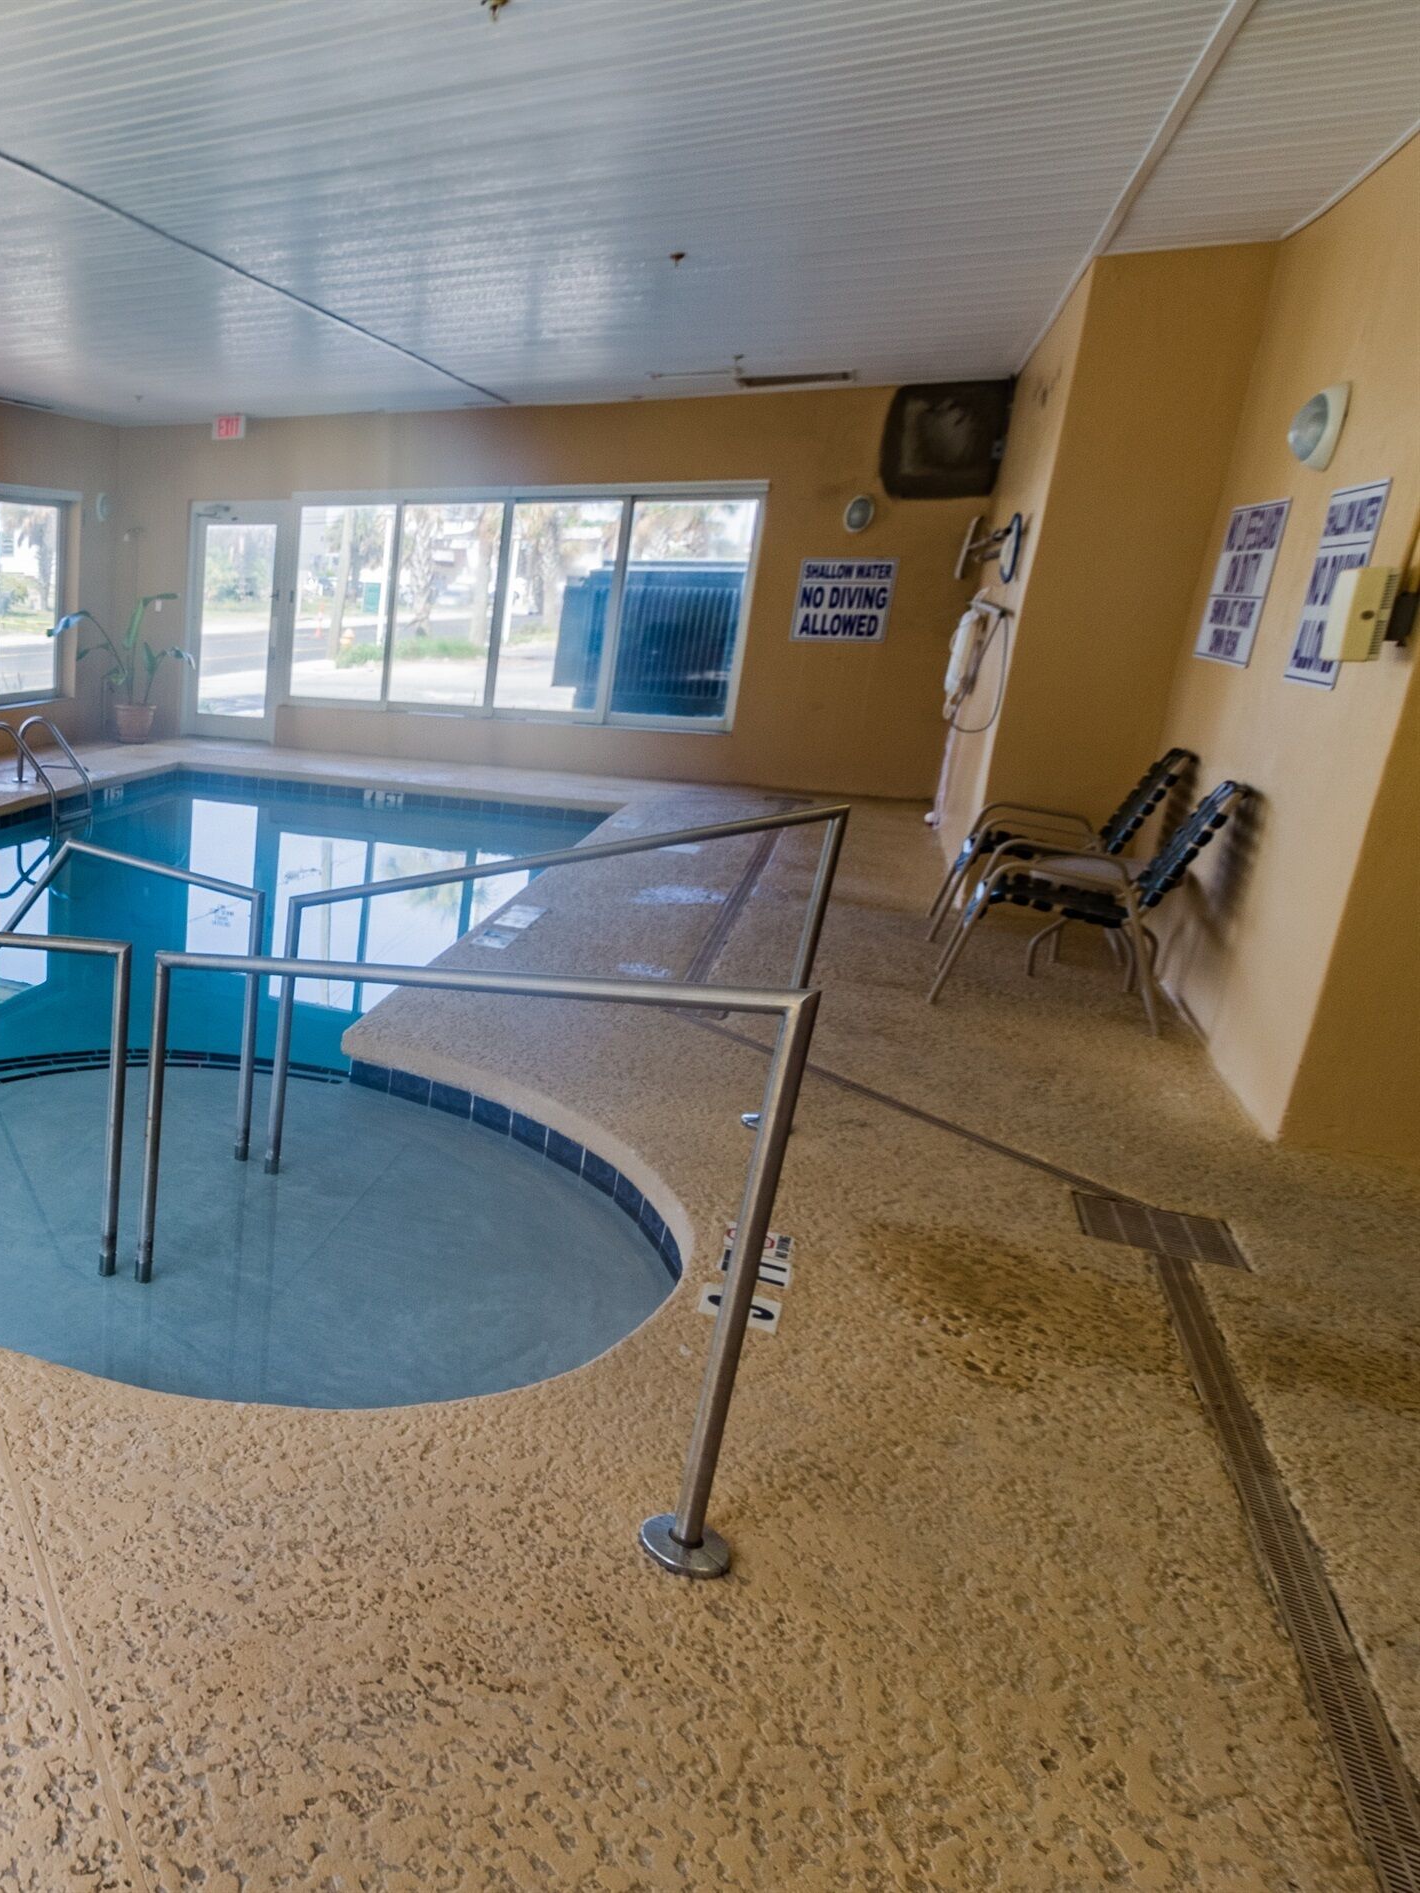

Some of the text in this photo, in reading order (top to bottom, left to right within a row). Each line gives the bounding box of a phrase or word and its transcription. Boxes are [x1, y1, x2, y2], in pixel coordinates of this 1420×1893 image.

[218, 417, 241, 436] EXIT
[805, 564, 893, 580] SHALLOW WATER
[800, 586, 888, 610] NO DIVING
[799, 613, 879, 637] ALLOWED
